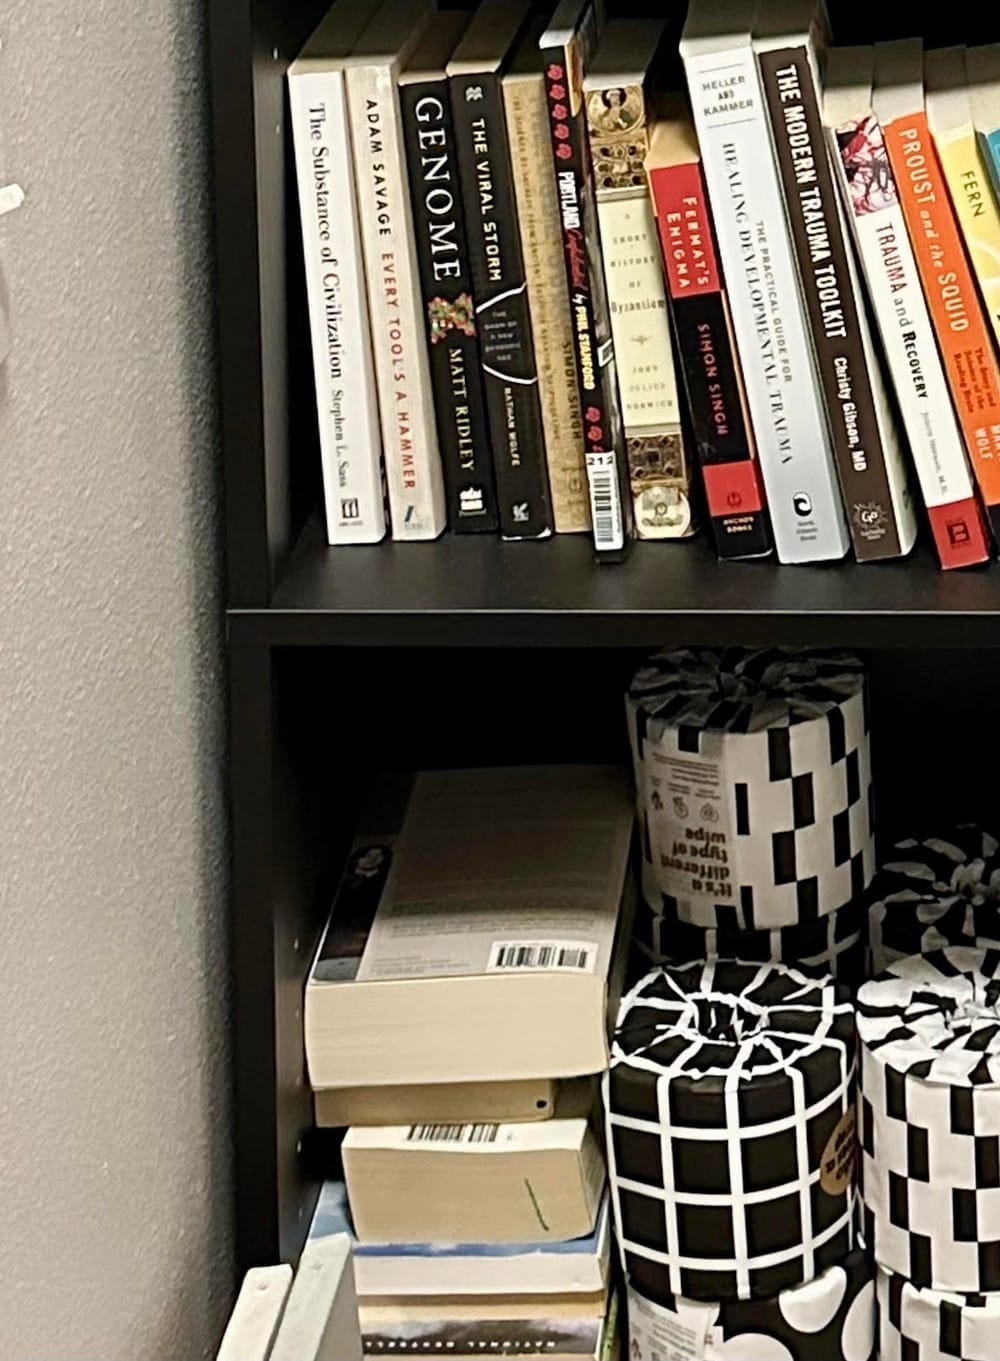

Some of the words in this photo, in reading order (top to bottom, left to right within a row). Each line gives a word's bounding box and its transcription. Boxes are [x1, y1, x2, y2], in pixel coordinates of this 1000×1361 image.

[703, 99, 754, 116] KAMMER
[775, 63, 797, 103] THE
[308, 102, 326, 137] The
[366, 99, 382, 155] ADAM
[471, 119, 487, 154] THE
[783, 104, 817, 186] MODERN
[311, 144, 331, 244] Substance
[414, 95, 461, 281] GENOME
[476, 160, 495, 218] VIRAL
[899, 127, 936, 204] PROUST
[960, 170, 985, 218] FERN
[372, 163, 392, 236] SAVAGE
[800, 186, 831, 263] TRAUMA
[921, 209, 940, 241] and
[318, 248, 338, 267] of
[482, 221, 502, 283] STORM
[666, 212, 692, 289] ENIGMA
[682, 196, 710, 286] FERMAT'S
[755, 220, 766, 243] THE
[930, 244, 945, 268] the
[611, 298, 666, 315] Byzantium
[722, 142, 749, 228] HEALING
[739, 229, 775, 386] DEVELOPMENTAL
[768, 389, 794, 465] TRAUMA
[759, 246, 779, 315] PRACTICAL
[812, 263, 847, 338] TOOLKIT
[938, 271, 970, 332] SQUID
[320, 272, 344, 380] Civilization
[772, 316, 787, 357] GUIDE
[448, 348, 469, 400] MATT
[697, 323, 718, 380] SIMON
[708, 381, 729, 437] SINGH
[782, 359, 793, 383] FOR
[454, 404, 477, 472] RIDLEY
